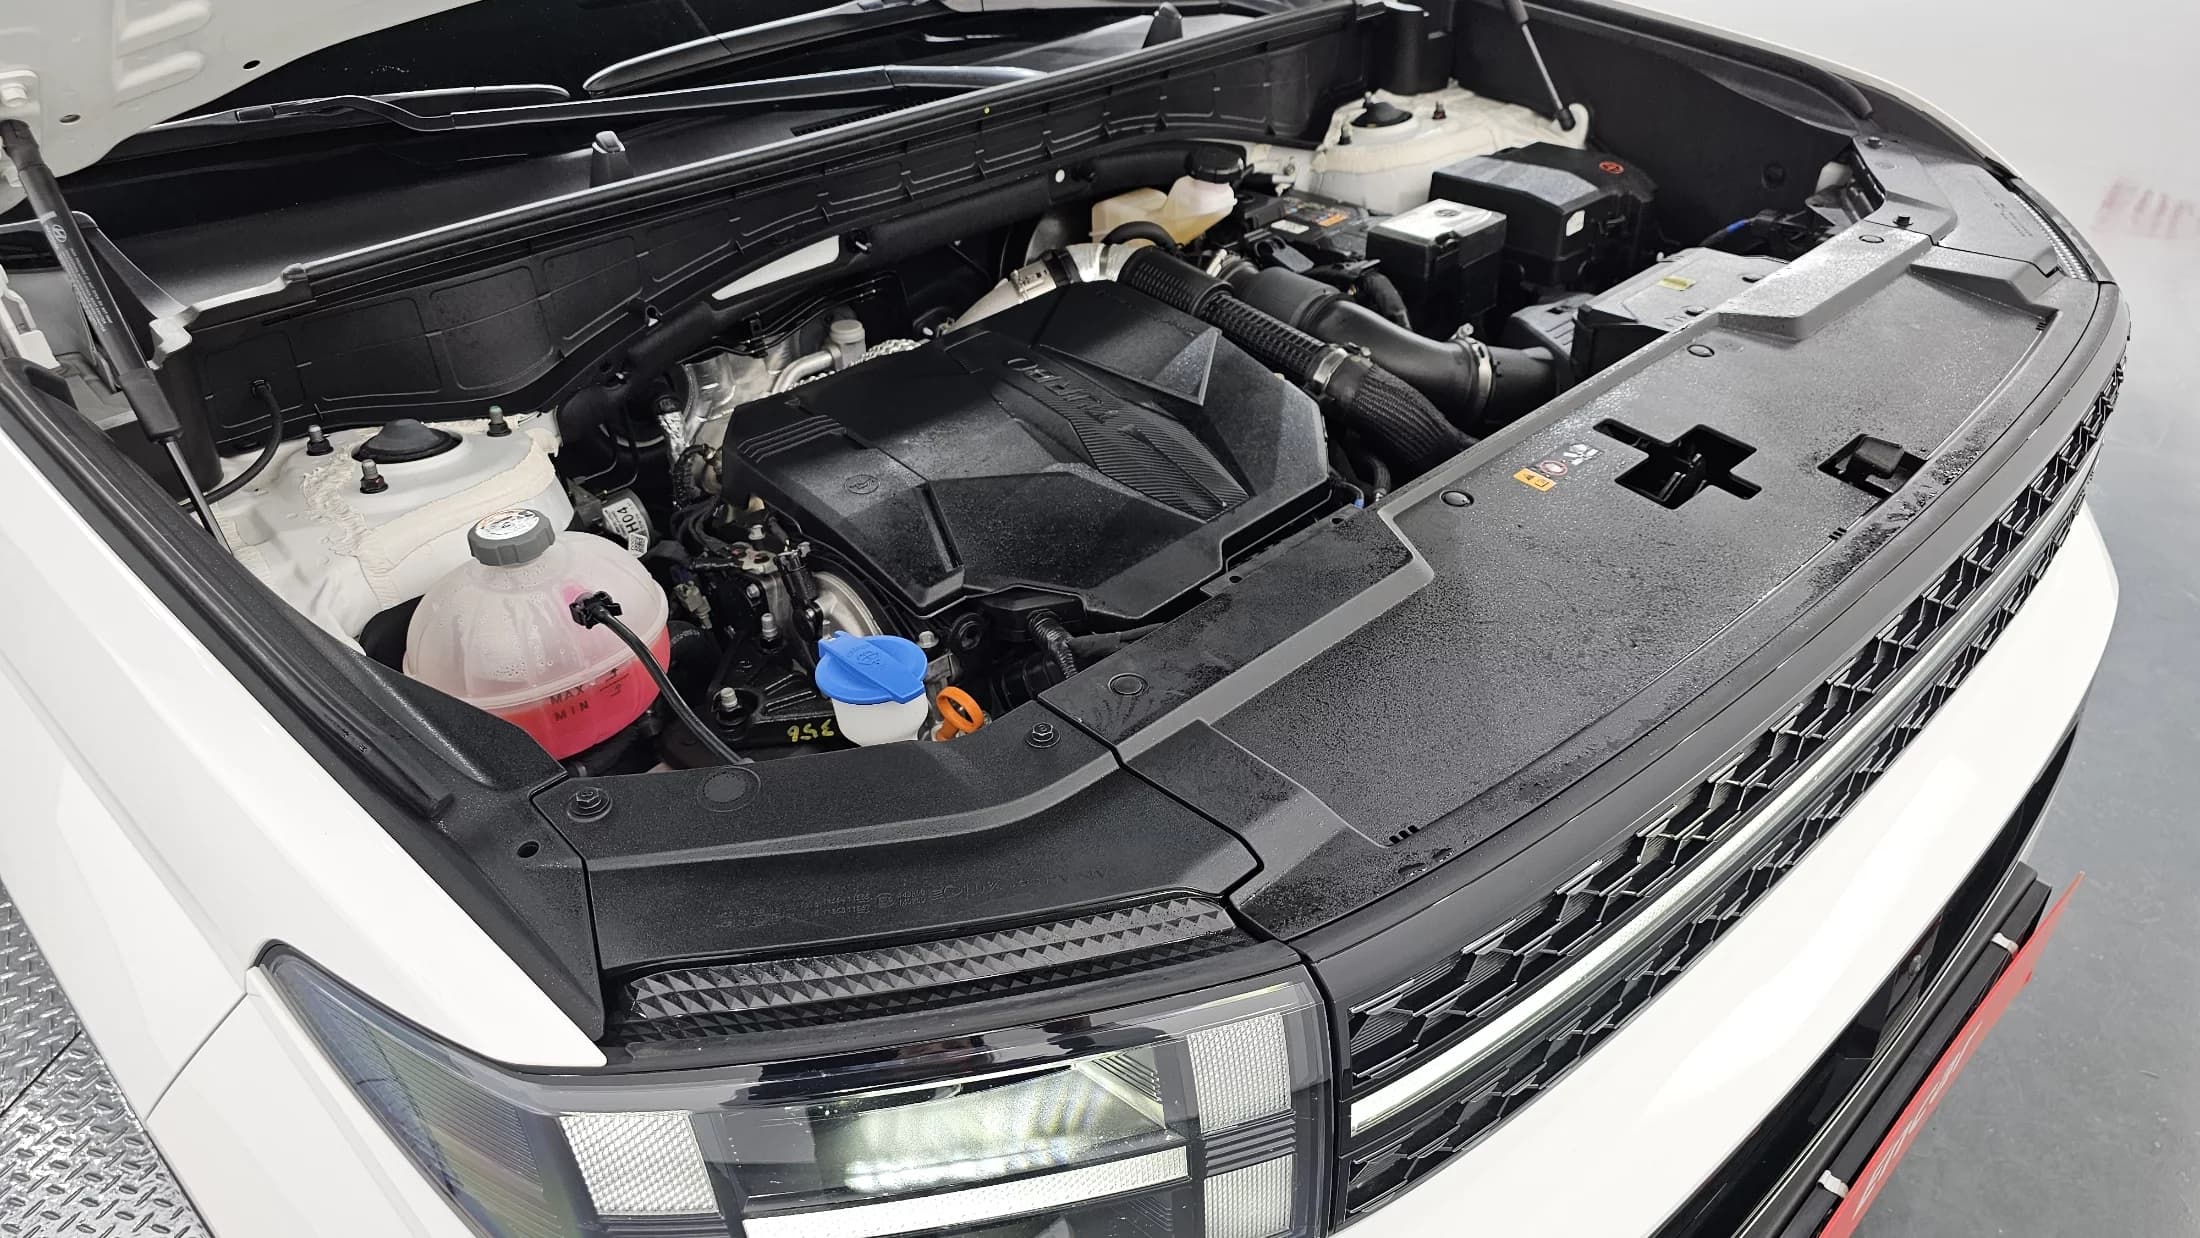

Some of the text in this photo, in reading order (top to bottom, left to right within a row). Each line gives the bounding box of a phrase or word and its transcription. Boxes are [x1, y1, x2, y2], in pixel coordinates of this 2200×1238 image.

[616, 506, 639, 534] H04
[549, 684, 585, 705] MAX
[554, 700, 589, 721] MIN
